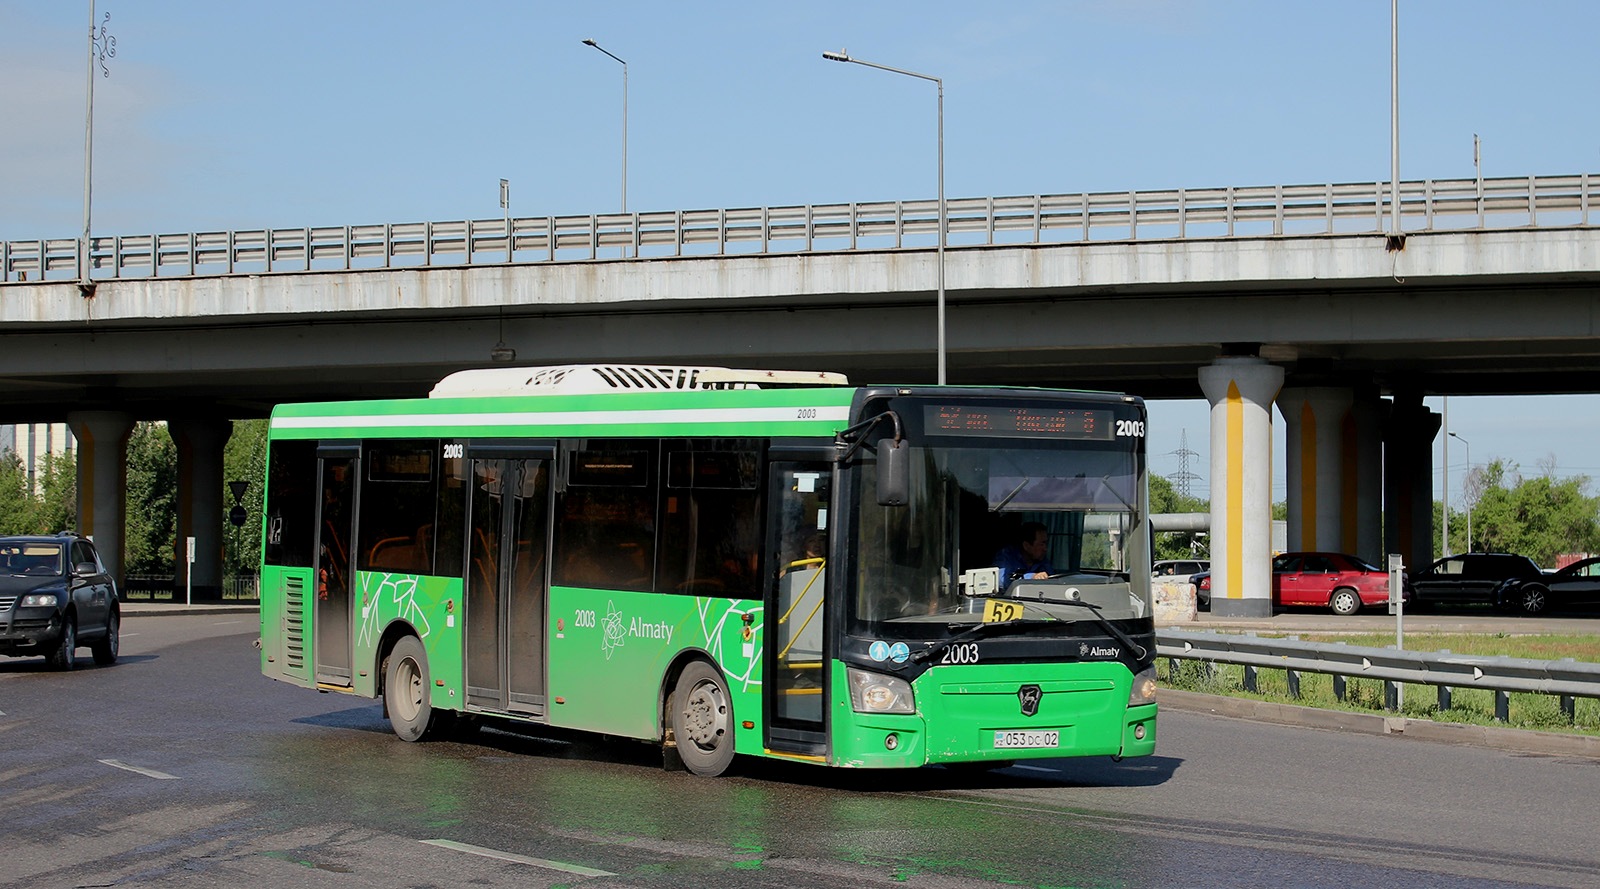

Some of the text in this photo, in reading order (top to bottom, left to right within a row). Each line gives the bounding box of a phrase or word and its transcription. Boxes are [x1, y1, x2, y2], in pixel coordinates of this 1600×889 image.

[797, 408, 817, 419] 2003
[1115, 419, 1145, 438] 2003
[443, 443, 463, 459] 2003
[992, 602, 1015, 622] 52
[574, 609, 674, 645] 2003 Almaty
[940, 643, 1120, 664] 2003 Almaty
[1005, 732, 1026, 746] 053
[1027, 735, 1041, 746] DC
[1044, 732, 1058, 746] 02
